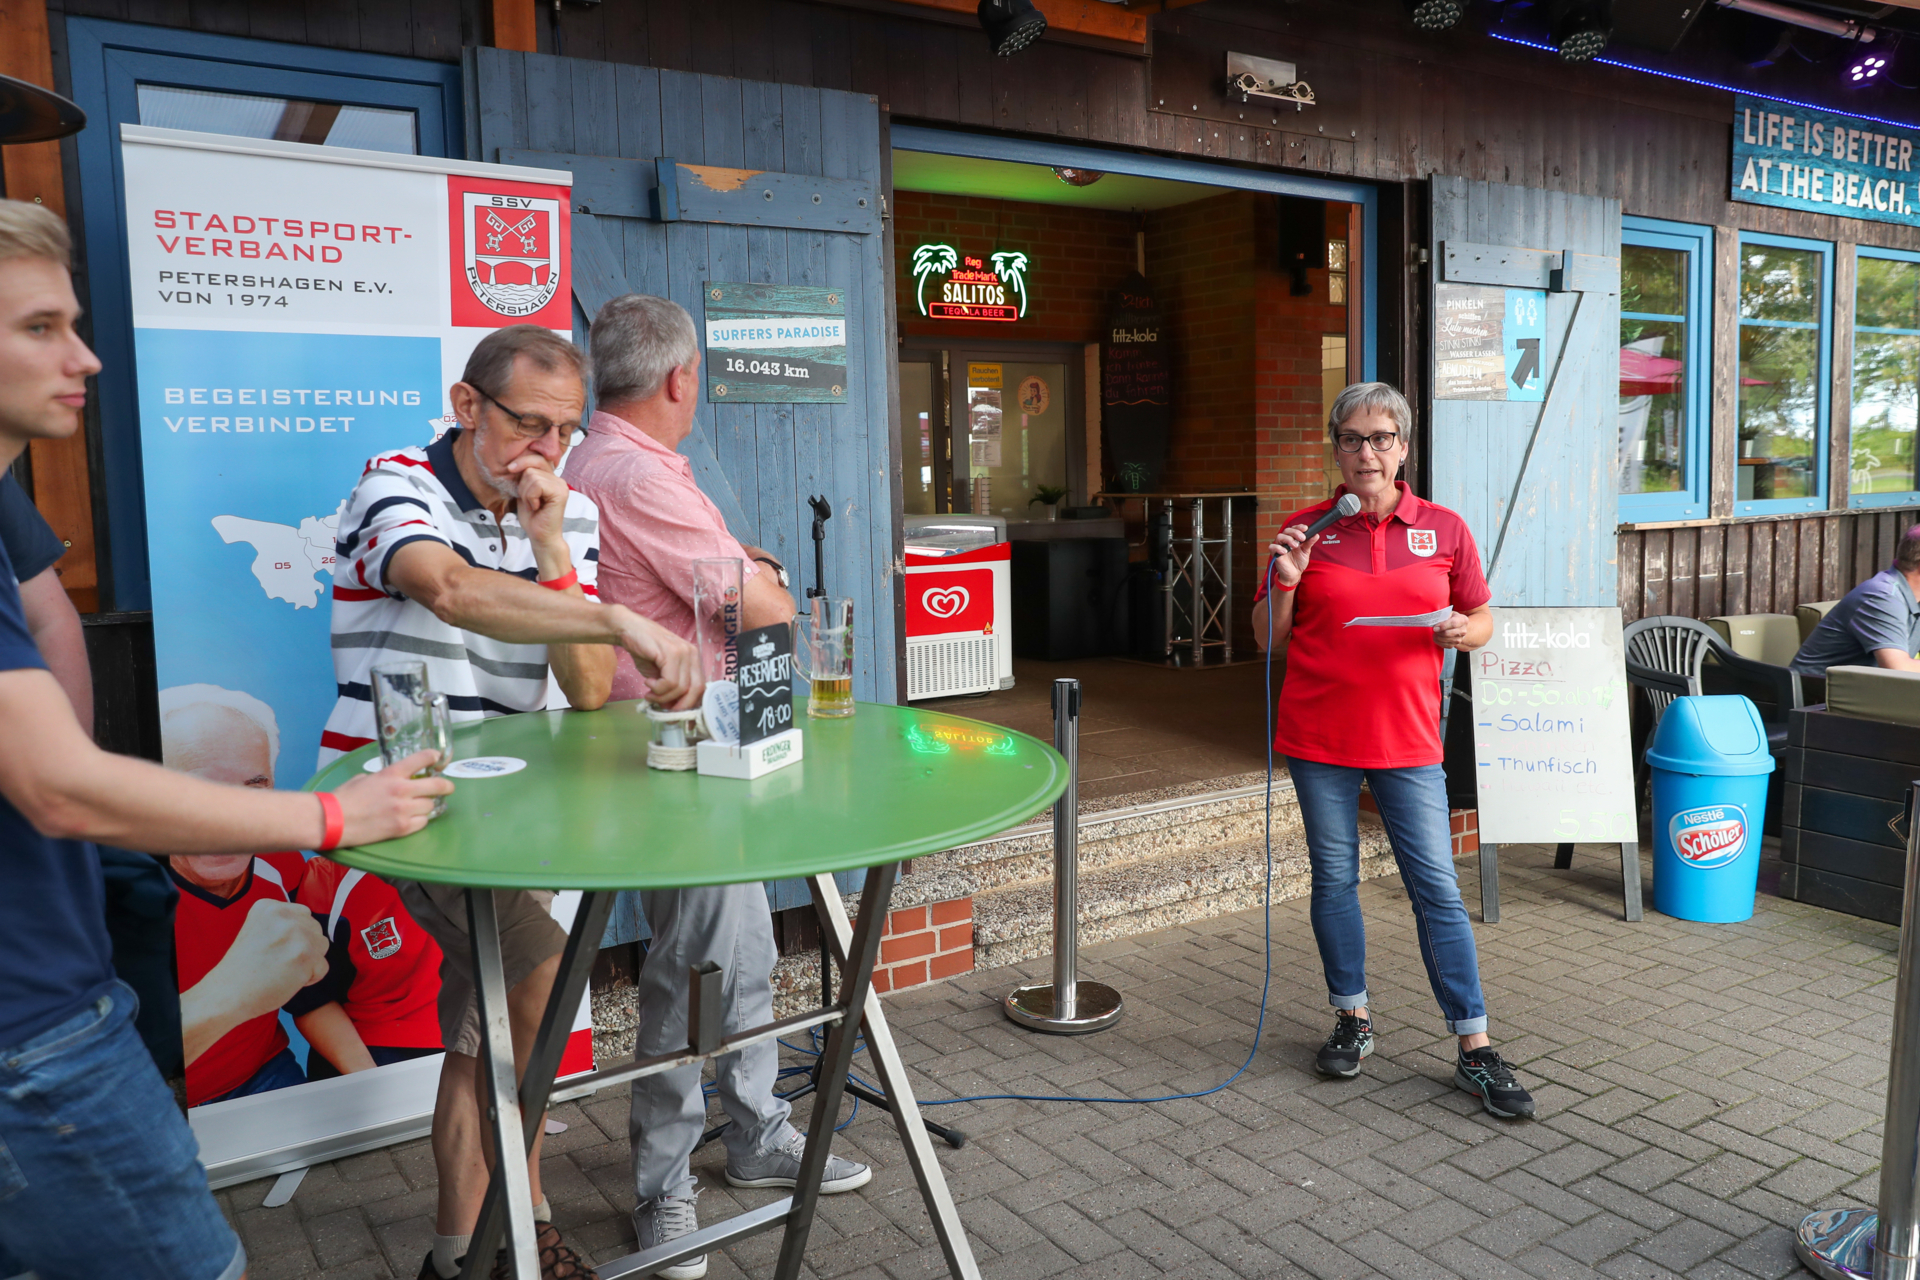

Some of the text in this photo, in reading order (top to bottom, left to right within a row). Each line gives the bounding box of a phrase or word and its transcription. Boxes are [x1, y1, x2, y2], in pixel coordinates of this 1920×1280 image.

[1743, 108, 1913, 172] LIFE IS BETTER
[1739, 156, 1912, 216] AT THE BEACH.
[491, 196, 532, 209] SSV
[154, 209, 413, 245] STADTSPORT-
[156, 234, 344, 264] VERBAND
[964, 256, 983, 269] Reg
[159, 271, 393, 294] PETERSHAGEN E.V.
[467, 266, 558, 315] PETERSHAGEN
[158, 290, 289, 308] VON 1974
[943, 283, 1005, 305] SALITOS
[943, 306, 1005, 317] TEQUILA BEER
[1446, 299, 1484, 310] PINKELN
[712, 325, 840, 342] SURFERS PARADISE
[1449, 349, 1497, 358] WASSER LASSEN
[726, 358, 810, 379] 16.043 km
[164, 387, 422, 406] BEGEISTERUNG
[162, 416, 356, 433] VERBINDET
[274, 562, 291, 570] 05
[321, 556, 336, 564] 26
[1480, 651, 1554, 677] Pizza
[757, 703, 792, 737] 18:00
[1497, 712, 1584, 734] Salami
[1497, 757, 1597, 774] Thunfisch
[1679, 822, 1742, 859] Schöller
